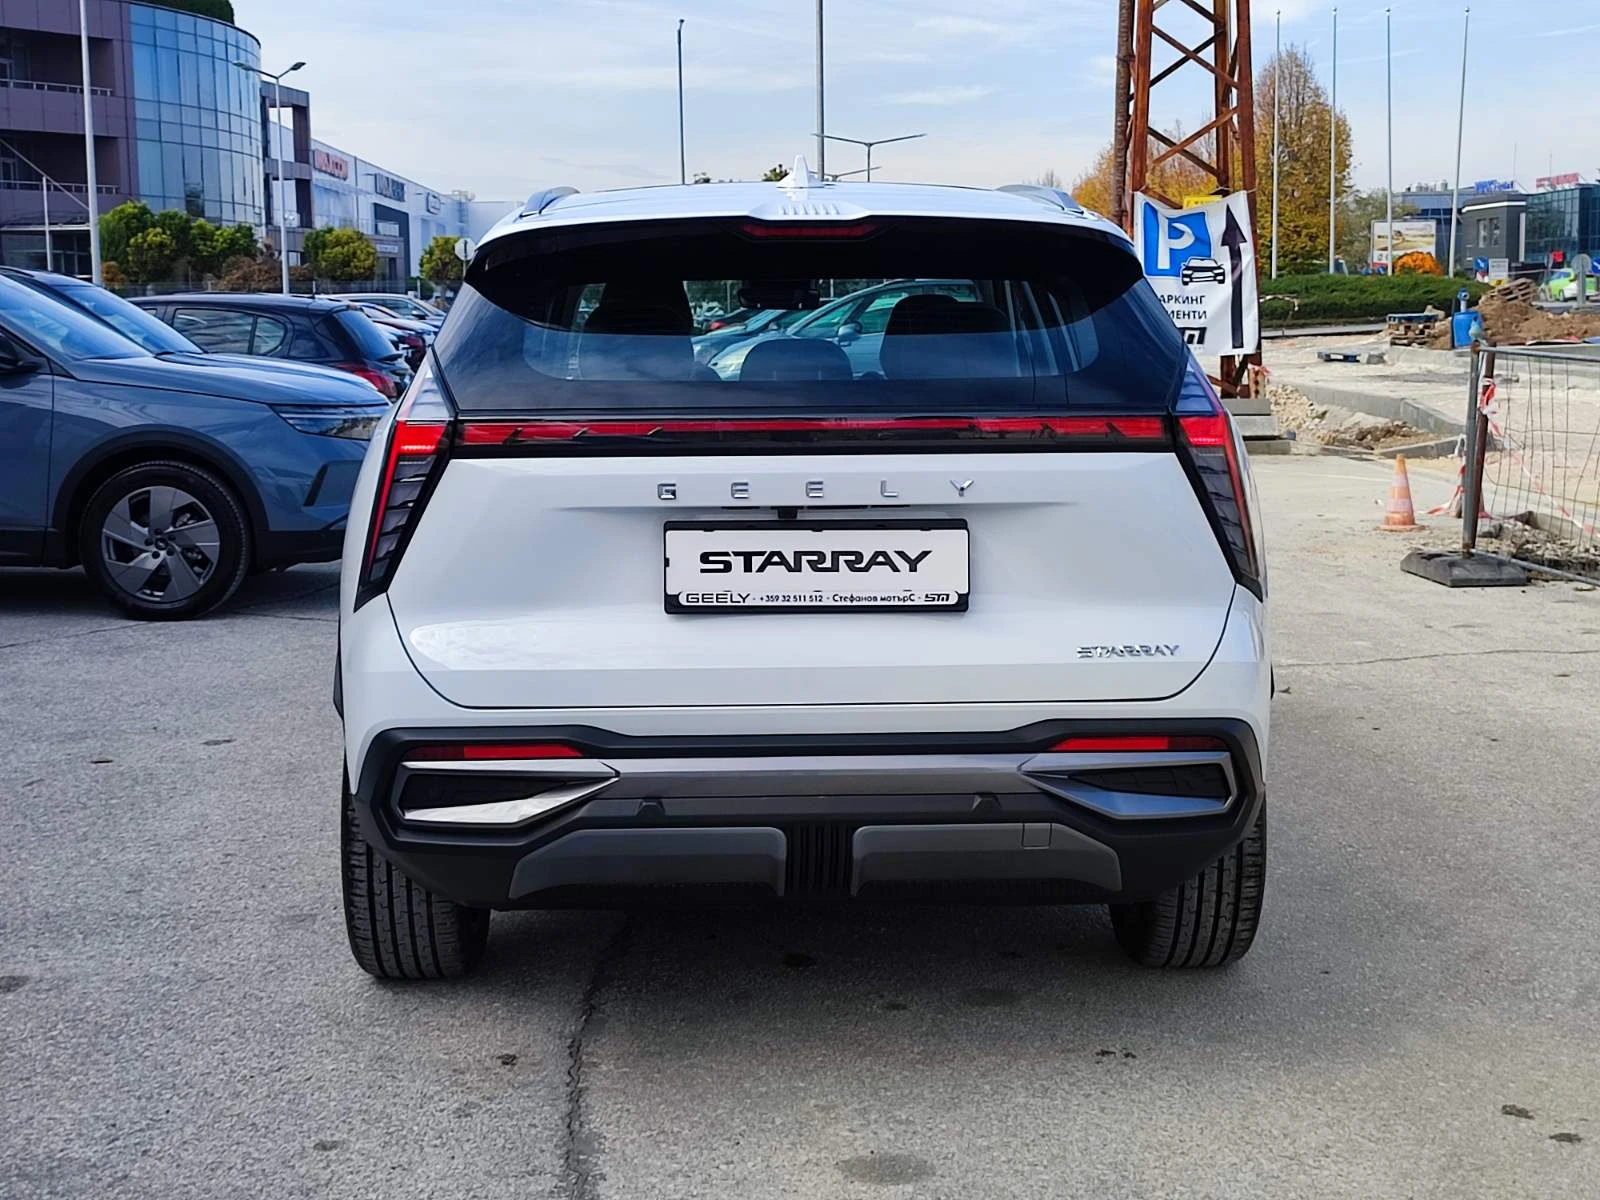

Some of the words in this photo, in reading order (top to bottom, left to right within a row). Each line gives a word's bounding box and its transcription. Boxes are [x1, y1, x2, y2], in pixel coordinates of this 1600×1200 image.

[1157, 213, 1195, 269] P
[1160, 295, 1206, 304] АРКИНГ
[657, 480, 974, 500] GEELY
[699, 550, 933, 573] STARRAY
[686, 593, 750, 603] GEELY
[832, 593, 878, 603] Стефанов
[1077, 644, 1180, 658] STARRAY
